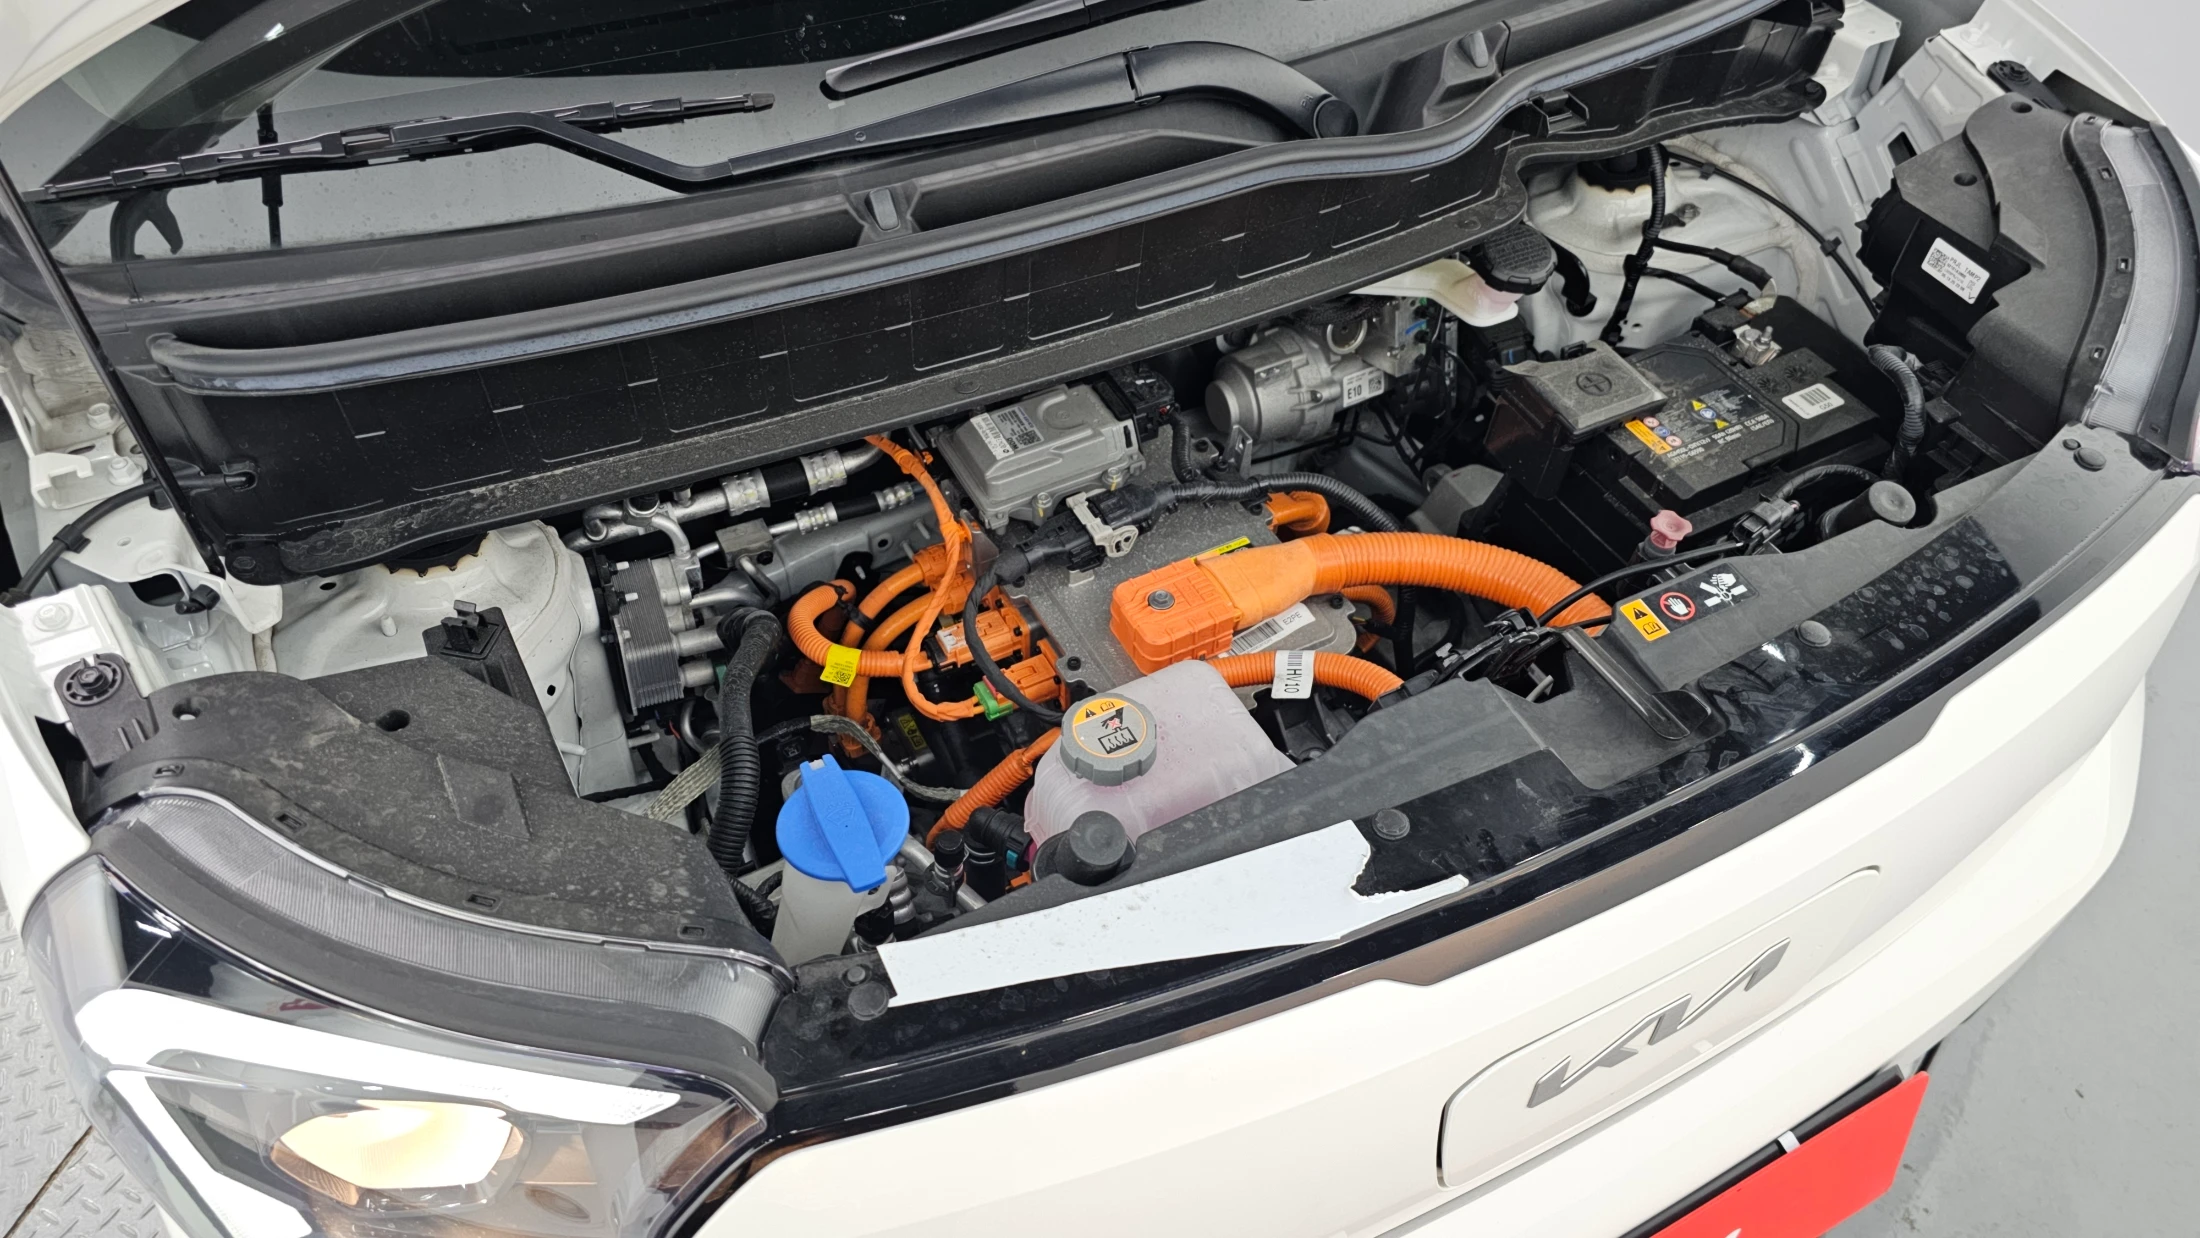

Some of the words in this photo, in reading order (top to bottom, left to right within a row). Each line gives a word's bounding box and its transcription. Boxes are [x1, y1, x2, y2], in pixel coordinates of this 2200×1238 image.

[1347, 384, 1362, 400] E10
[1282, 611, 1302, 625] E2PE
[1284, 668, 1302, 693] HV10
